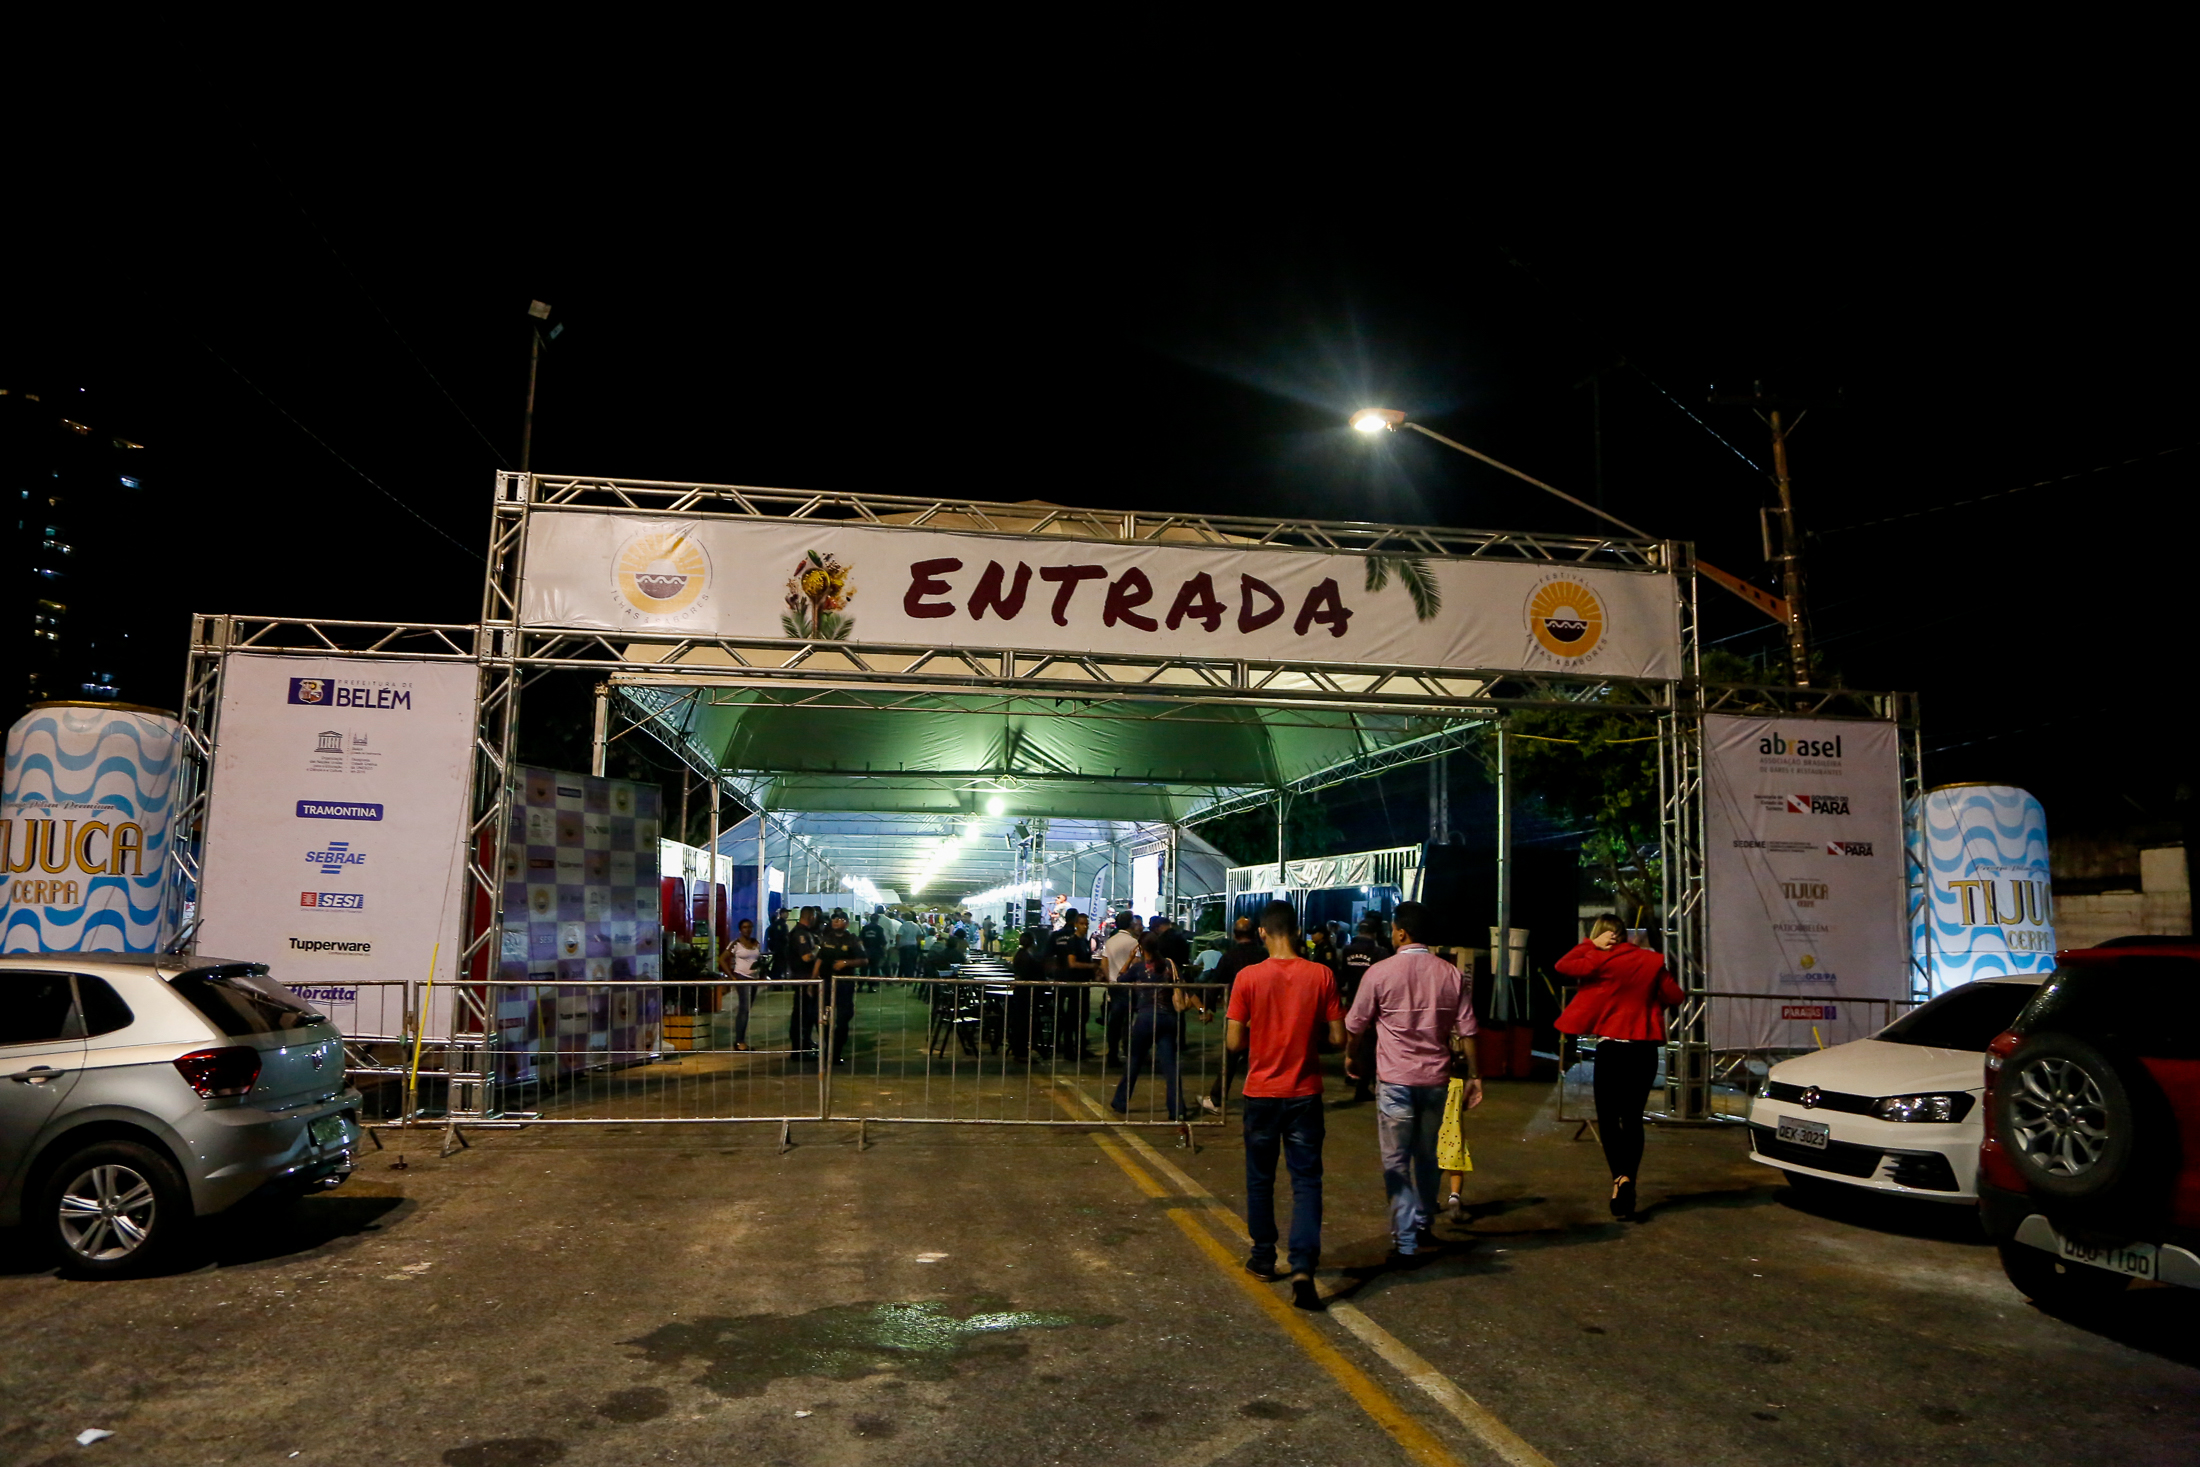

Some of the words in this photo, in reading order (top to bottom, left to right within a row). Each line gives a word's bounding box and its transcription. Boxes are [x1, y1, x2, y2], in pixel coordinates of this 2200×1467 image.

[1539, 572, 1589, 587] FESTIVAL
[904, 557, 1354, 638] ENTRADA
[338, 679, 396, 688] PREFEITURA
[336, 687, 411, 711] BELÉM
[1760, 732, 1841, 758] abrasel
[303, 805, 377, 818] TRAMONTINA
[0, 818, 144, 877] IJUCA
[1733, 840, 1767, 849] SEDEME
[305, 851, 366, 865] SEBRAE
[12, 879, 79, 905] CERPA
[1782, 883, 1829, 900] TIJUCA
[321, 894, 361, 908] SESI
[289, 937, 371, 952] Tupperware
[1784, 1007, 1822, 1018] PARAS
